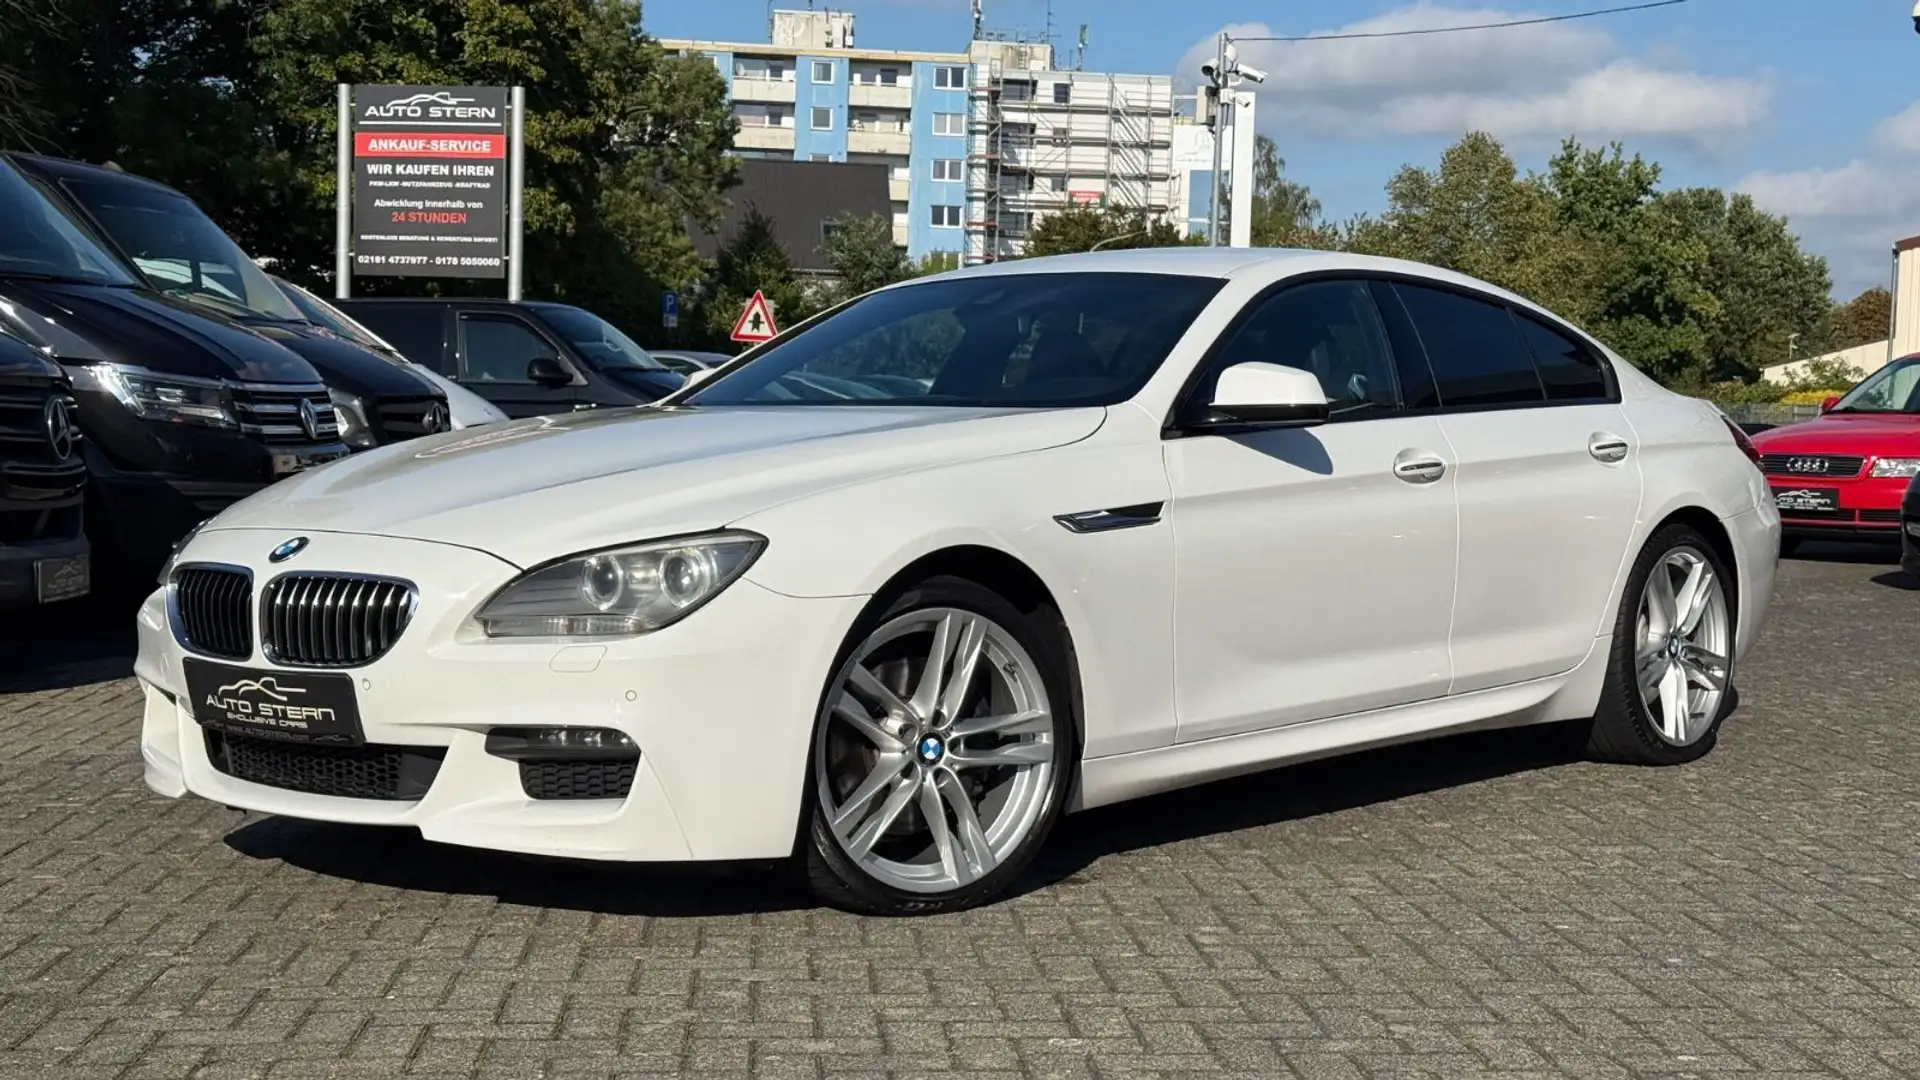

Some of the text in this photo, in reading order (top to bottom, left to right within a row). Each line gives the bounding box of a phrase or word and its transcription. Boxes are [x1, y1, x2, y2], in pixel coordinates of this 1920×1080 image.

[365, 106, 495, 118] AUTO STERN
[368, 139, 491, 153] ANKAUF-SERVICE
[366, 164, 494, 176] WIR KAUFEN IHREN
[374, 199, 423, 210] Abwicklung
[391, 211, 467, 224] 24 STUNDEN
[206, 694, 336, 722] AUTO STERN
[226, 711, 308, 729] EXCLUSIVE CARS
